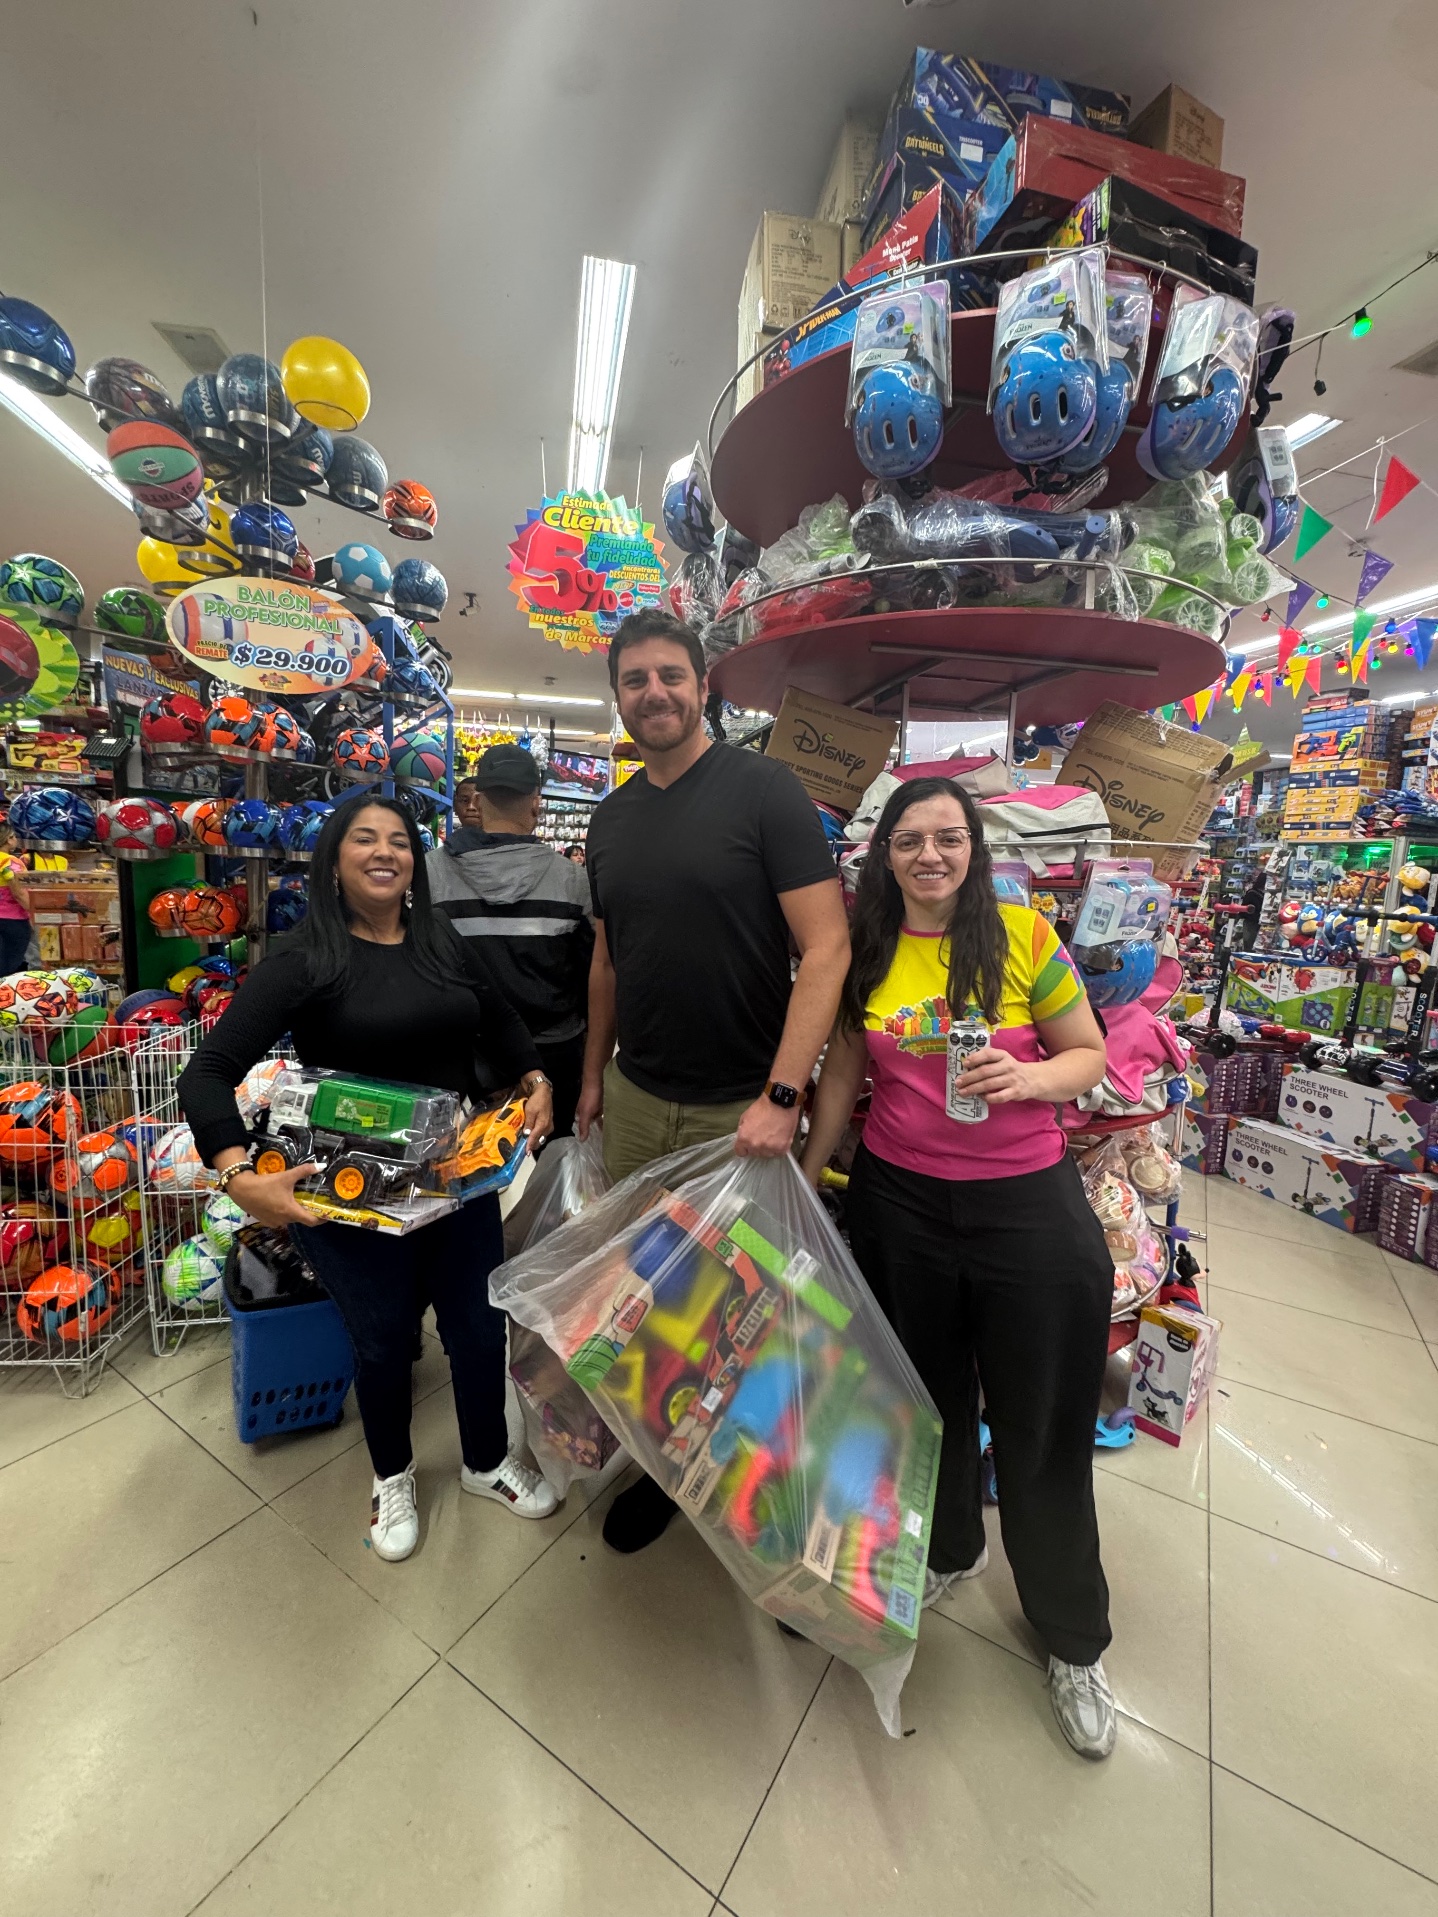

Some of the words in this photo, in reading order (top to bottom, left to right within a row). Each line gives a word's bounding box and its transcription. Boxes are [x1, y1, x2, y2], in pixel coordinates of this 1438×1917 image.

[542, 506, 639, 536] Cliente
[588, 533, 655, 552] Premiando
[587, 550, 600, 562] tu
[600, 550, 657, 567] fidelidad
[608, 570, 649, 582] DESCUENTOS
[649, 573, 661, 583] DEL
[236, 585, 313, 613] BALÓN
[203, 599, 344, 635] PROFESIONAL
[534, 615, 595, 627] nuestros
[541, 607, 565, 616] todos
[544, 630, 562, 642] de
[564, 631, 613, 646] Marcas
[194, 646, 229, 659] REMATE
[234, 643, 252, 666] $
[255, 648, 349, 676] 29.900
[104, 655, 145, 679] NUEVAS
[145, 664, 153, 682] Y
[154, 670, 199, 700] EXCLUSIVAS
[796, 764, 823, 780] SPORTING
[842, 781, 864, 794] SERIES
[1410, 992, 1428, 1037] SCOOTER
[1289, 1083, 1330, 1100] SCOOTER
[1291, 1076, 1318, 1091] THREE
[1319, 1083, 1349, 1099] WHEEL
[1235, 1137, 1271, 1157] SCOOTER
[1236, 1131, 1261, 1145] THREE
[1260, 1139, 1289, 1157] WHEEL
